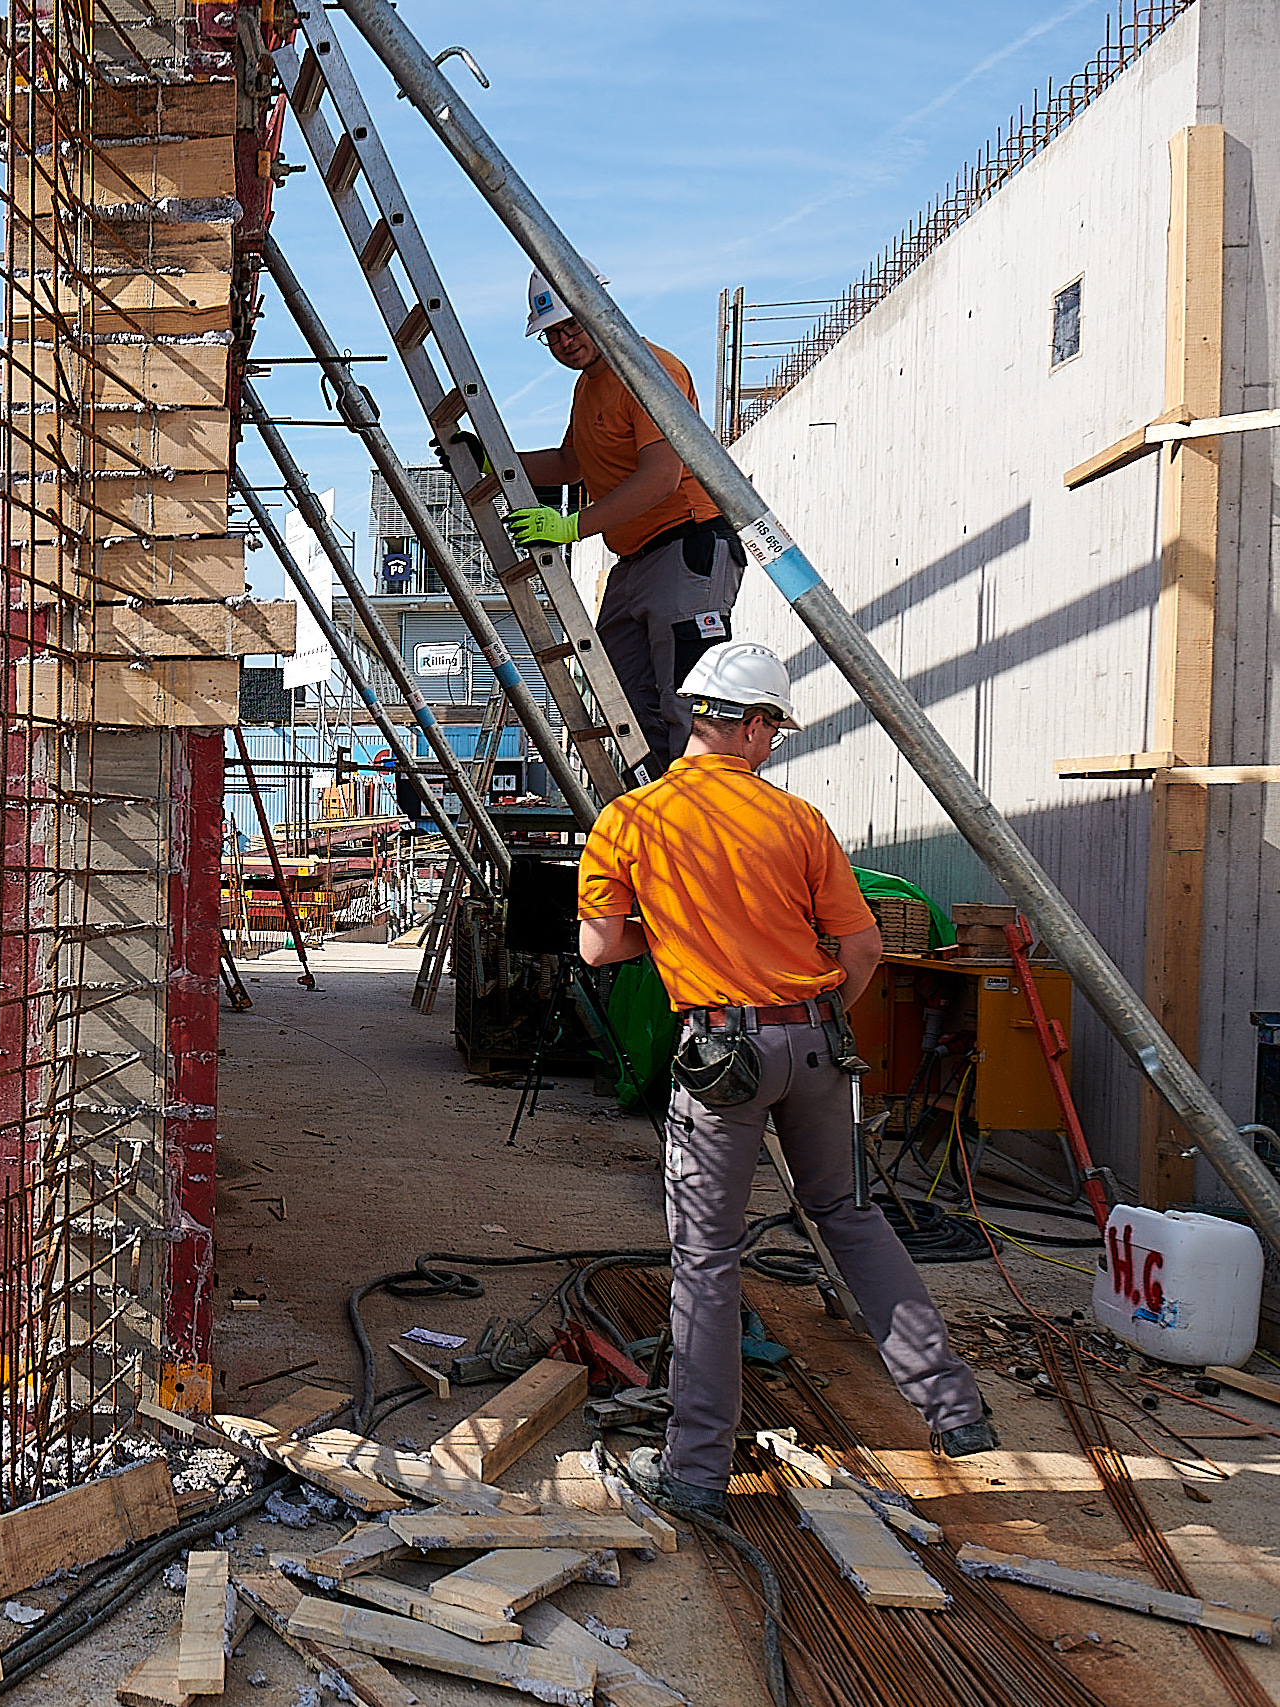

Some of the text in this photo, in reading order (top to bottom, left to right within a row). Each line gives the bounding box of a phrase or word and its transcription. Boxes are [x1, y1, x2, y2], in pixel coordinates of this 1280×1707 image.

[754, 520, 770, 536] RS
[390, 565, 404, 576] P6
[422, 655, 458, 668] Rilling
